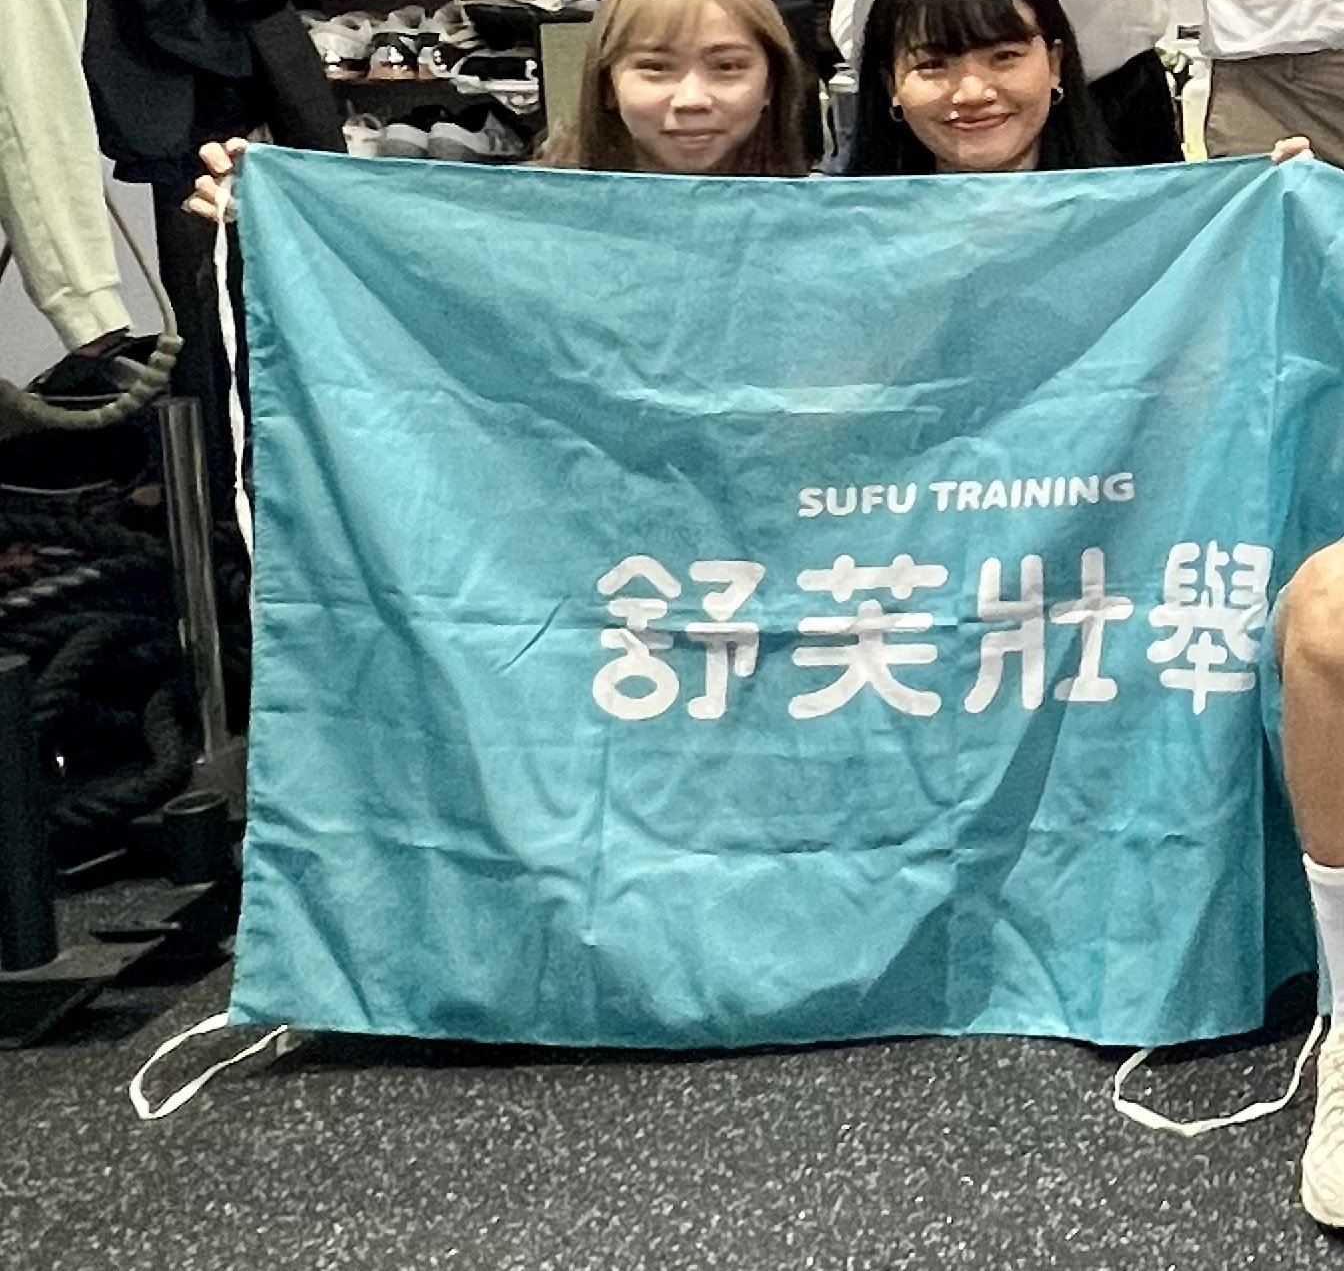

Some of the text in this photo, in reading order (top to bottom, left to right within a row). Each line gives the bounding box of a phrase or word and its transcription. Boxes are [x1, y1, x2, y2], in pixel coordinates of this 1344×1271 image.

[798, 472, 1135, 518] SUFU TRAINING
[592, 540, 1274, 720] 舒芙壯舉
